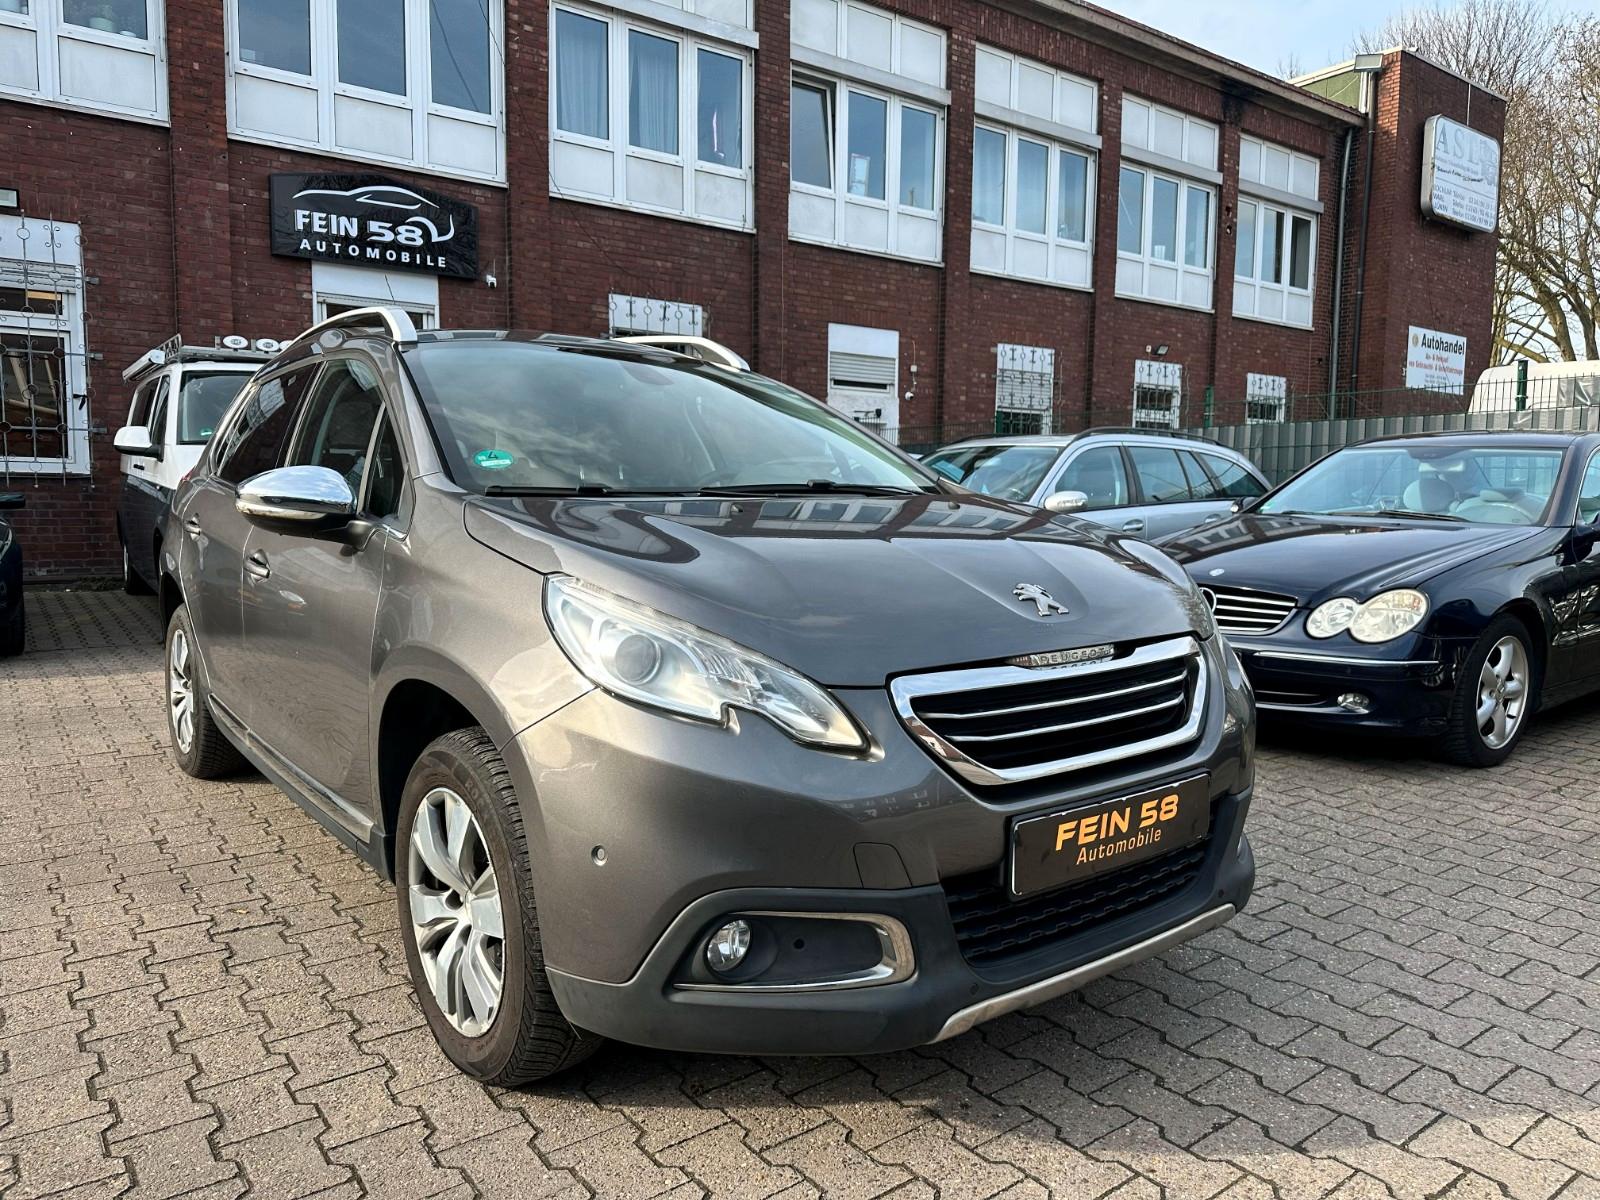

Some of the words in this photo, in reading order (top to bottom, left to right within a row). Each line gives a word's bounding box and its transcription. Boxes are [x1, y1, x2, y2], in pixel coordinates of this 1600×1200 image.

[295, 209, 358, 238] FEIN
[367, 220, 424, 247] 58
[300, 238, 447, 268] AUTOMOBILE
[1421, 333, 1465, 355] Autohandel
[1055, 807, 1131, 851] FEIN
[1139, 794, 1179, 828] 58
[1076, 828, 1162, 865] Automobile
